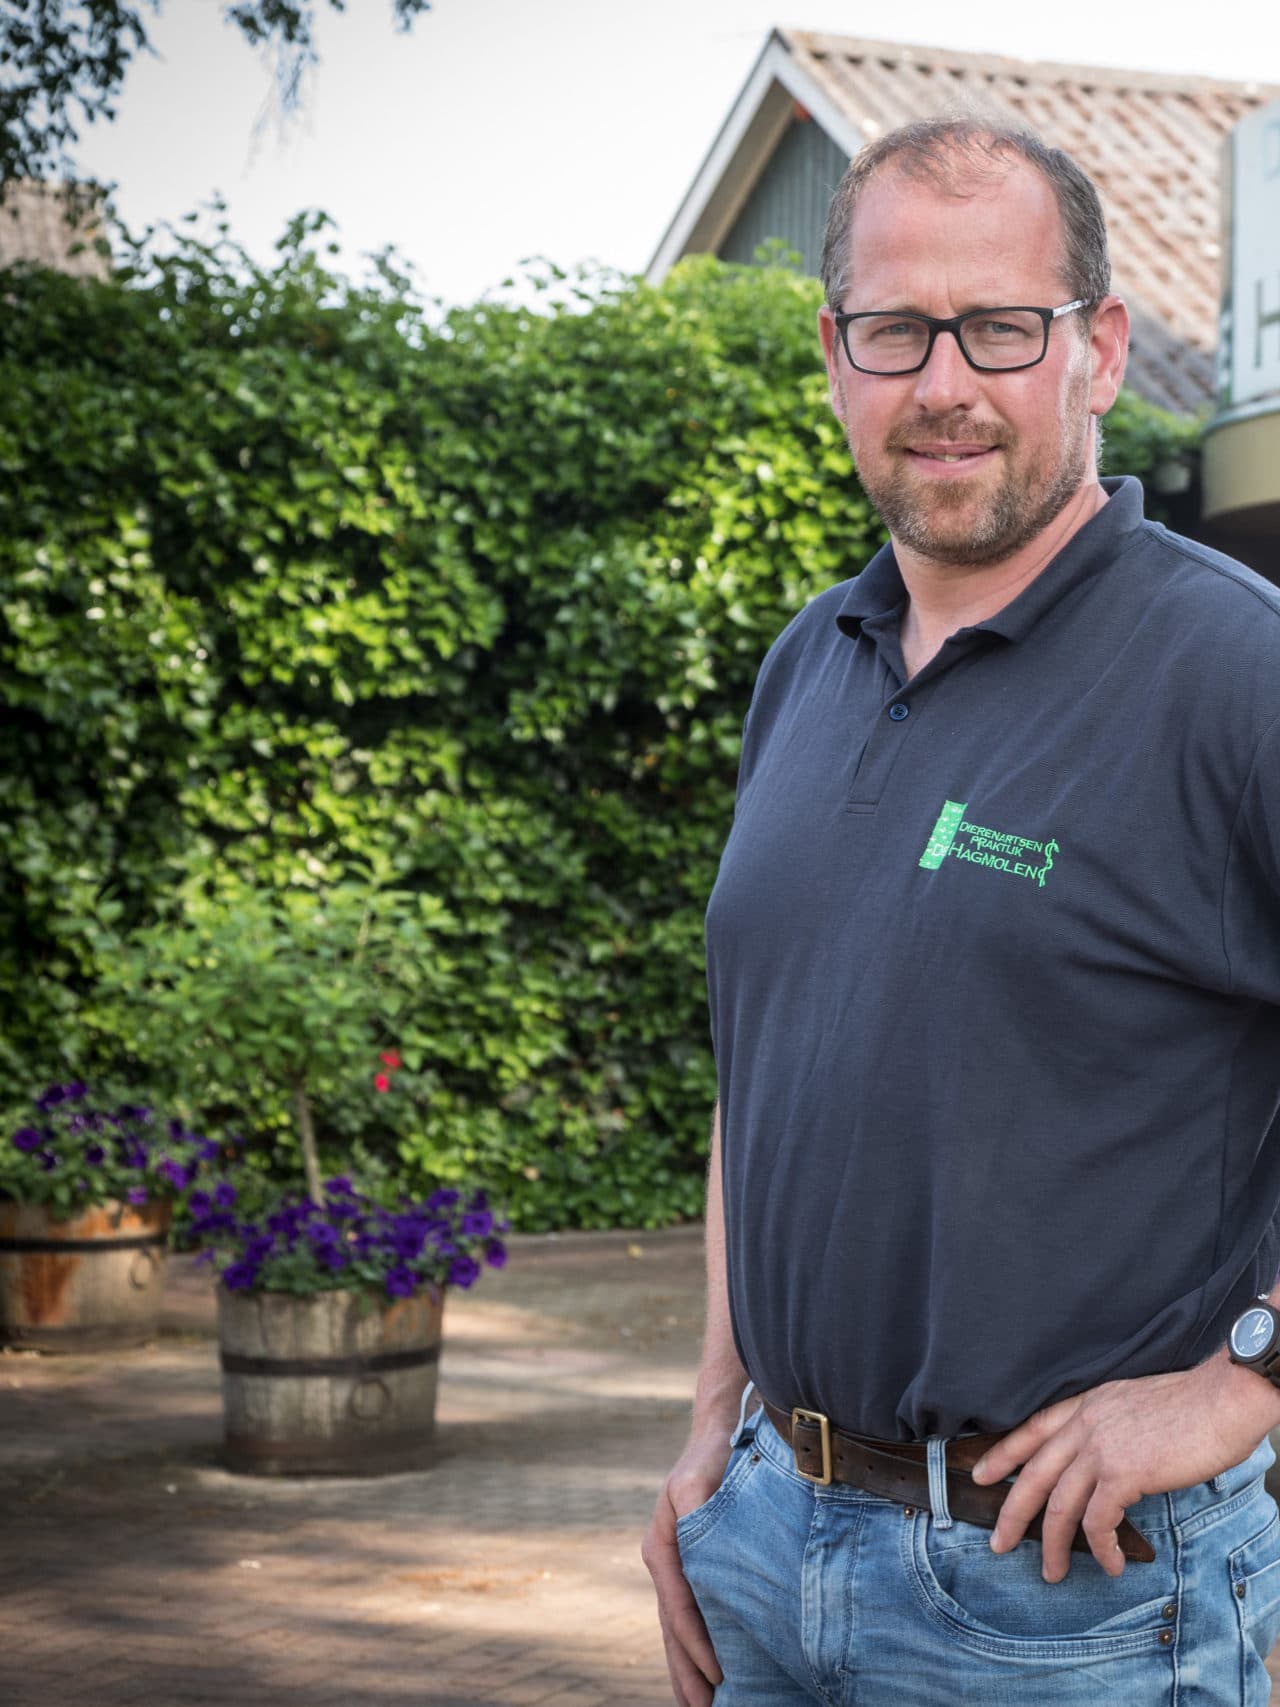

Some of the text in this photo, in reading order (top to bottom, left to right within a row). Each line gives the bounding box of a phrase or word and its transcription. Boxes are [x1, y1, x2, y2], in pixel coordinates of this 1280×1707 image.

[959, 821, 1043, 852] DIERENARTSEN
[970, 835, 1024, 857] PRAKTIJK
[947, 842, 1038, 879] HAGMOLEN
